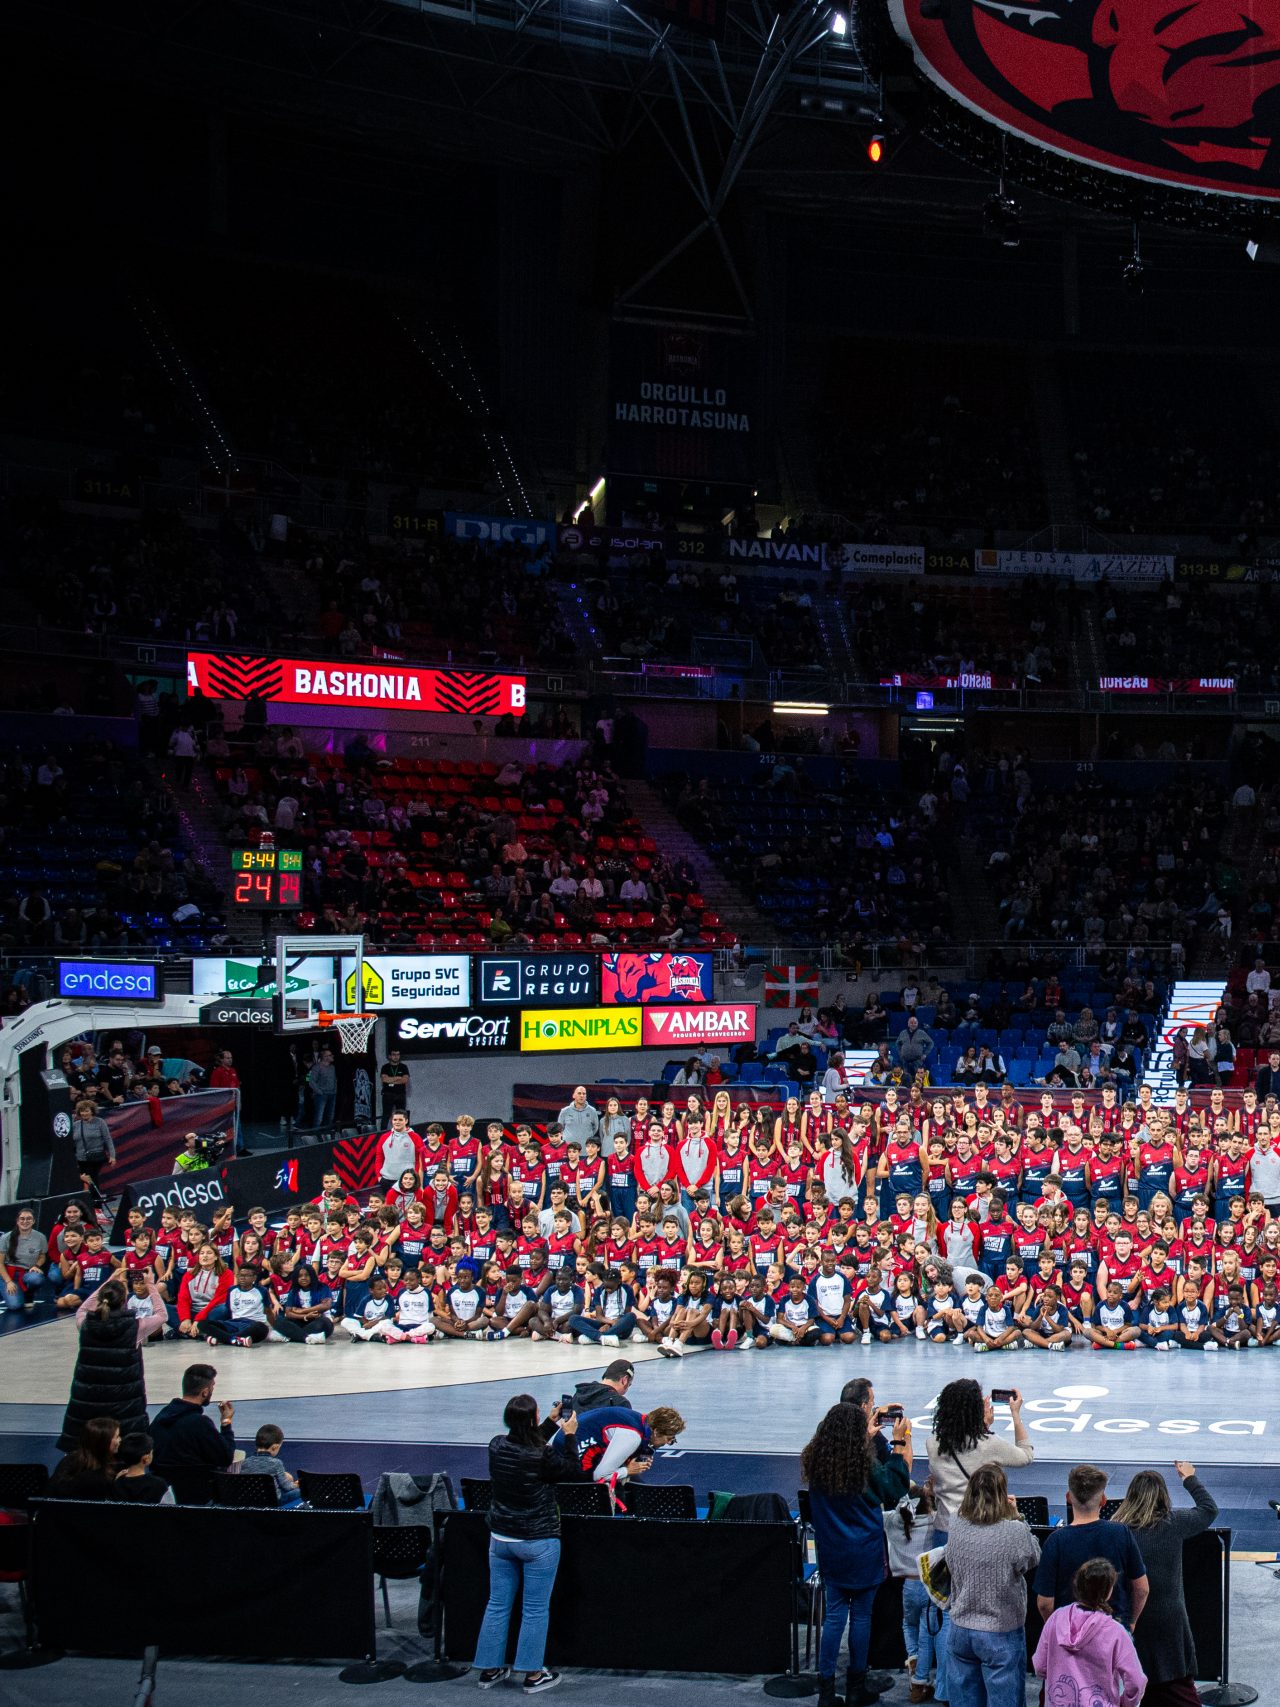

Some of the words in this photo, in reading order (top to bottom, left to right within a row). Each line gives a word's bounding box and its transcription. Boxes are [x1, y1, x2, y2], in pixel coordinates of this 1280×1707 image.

[640, 382, 727, 406] ORGULLO
[615, 402, 750, 432] HARROTASUNA
[83, 480, 131, 497] 311-A
[392, 514, 441, 530] 311-B
[455, 518, 546, 544] DIGI
[679, 540, 705, 554] 312
[729, 538, 819, 562] NAIVAN
[853, 551, 922, 567] Comeplastic
[928, 556, 970, 570] 313-A
[1179, 563, 1220, 576] 313-B
[295, 668, 422, 701] BASKONIA
[411, 735, 430, 747] 211
[759, 754, 777, 764] 212
[1076, 763, 1094, 772] 213
[242, 852, 275, 868] 9:44
[235, 873, 272, 903] 24
[279, 873, 300, 904] 24
[391, 969, 431, 982] Grupo
[435, 968, 459, 979] SVC
[525, 964, 590, 977] GRUPO
[63, 969, 152, 992] endesa
[526, 982, 589, 995] REGUI
[391, 985, 460, 999] Seguridad
[218, 1008, 273, 1023] endes
[668, 1011, 751, 1033] AMBAR
[398, 1016, 511, 1039] ServiCort
[524, 1017, 639, 1039] HORNIPLAS
[14, 1027, 45, 1053] SPALDING
[468, 1035, 507, 1047] SYSTEM
[911, 1413, 1266, 1436] edesa
